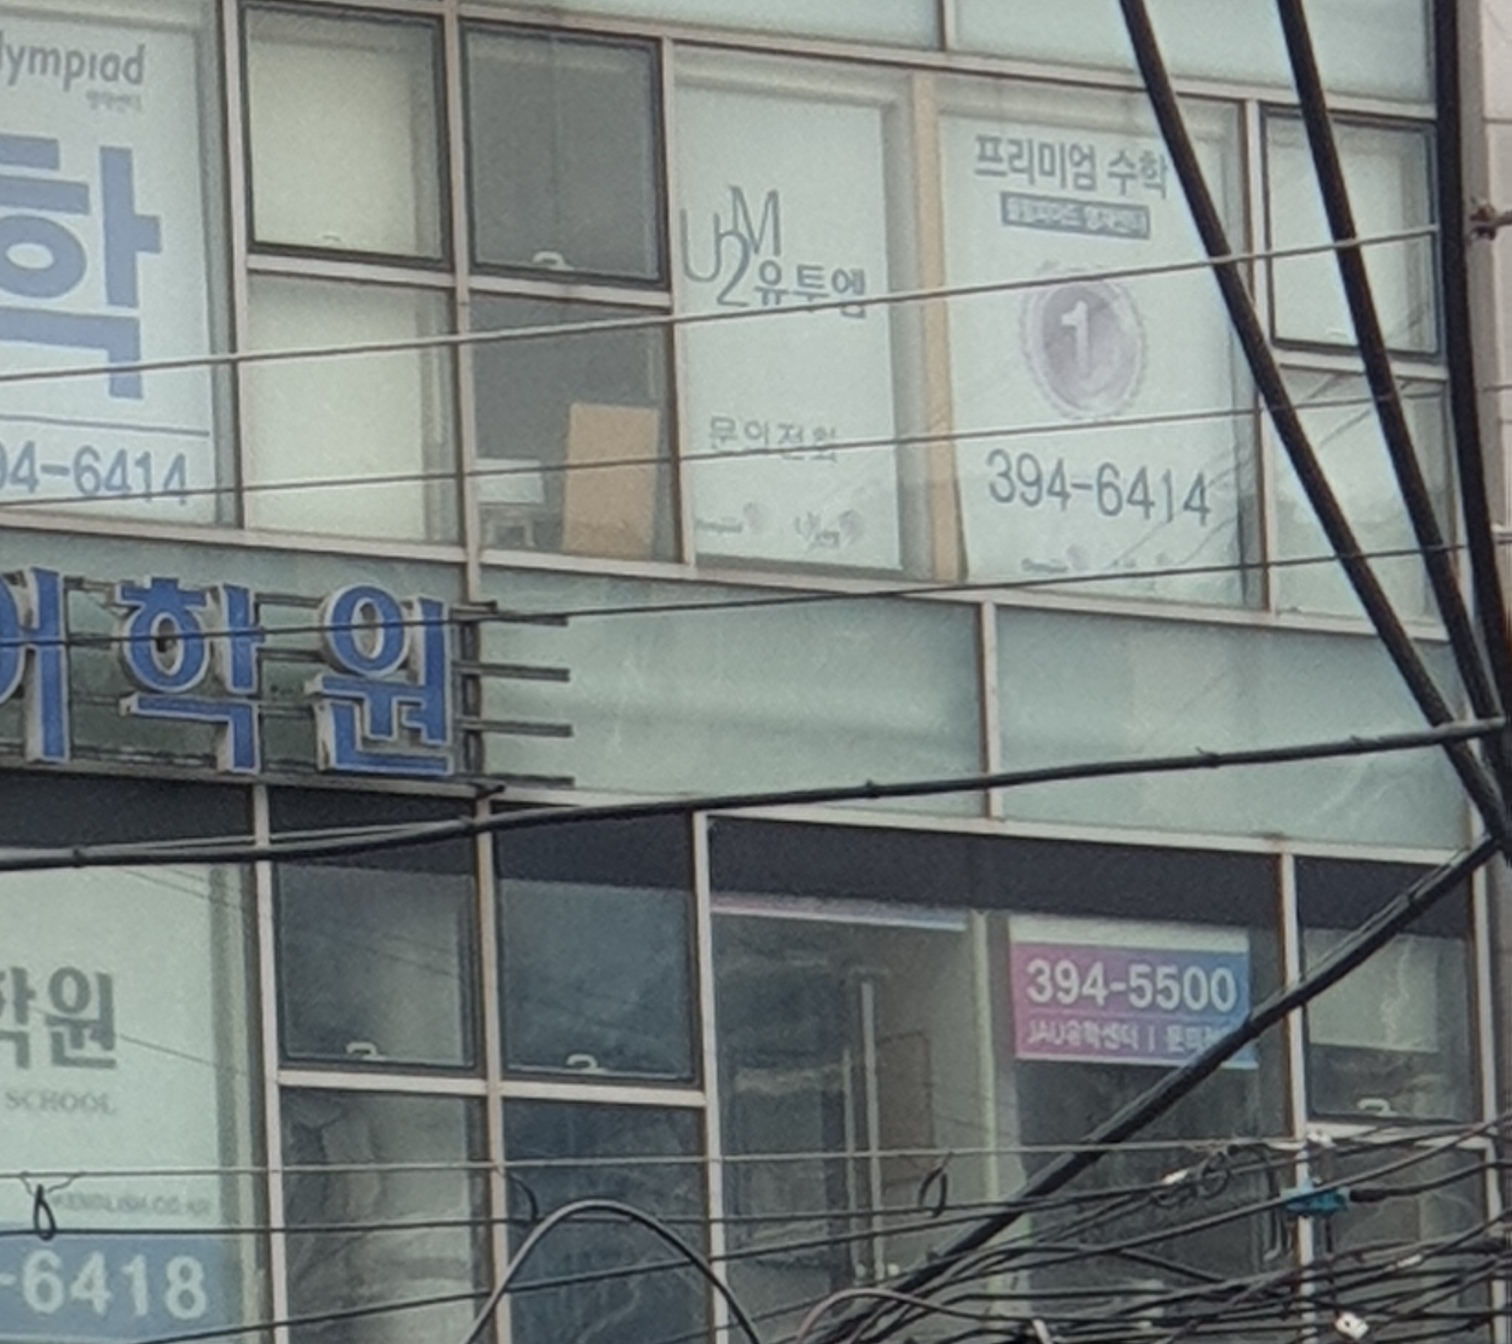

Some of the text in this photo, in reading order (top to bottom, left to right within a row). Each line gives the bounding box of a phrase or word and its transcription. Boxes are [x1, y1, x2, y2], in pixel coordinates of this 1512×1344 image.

[974, 134, 1169, 200] 프리미엄 수학
[987, 448, 1212, 527] 394-6414
[1026, 959, 1237, 1013] 394-5500
[3, 1087, 117, 1117] SCHOOL
